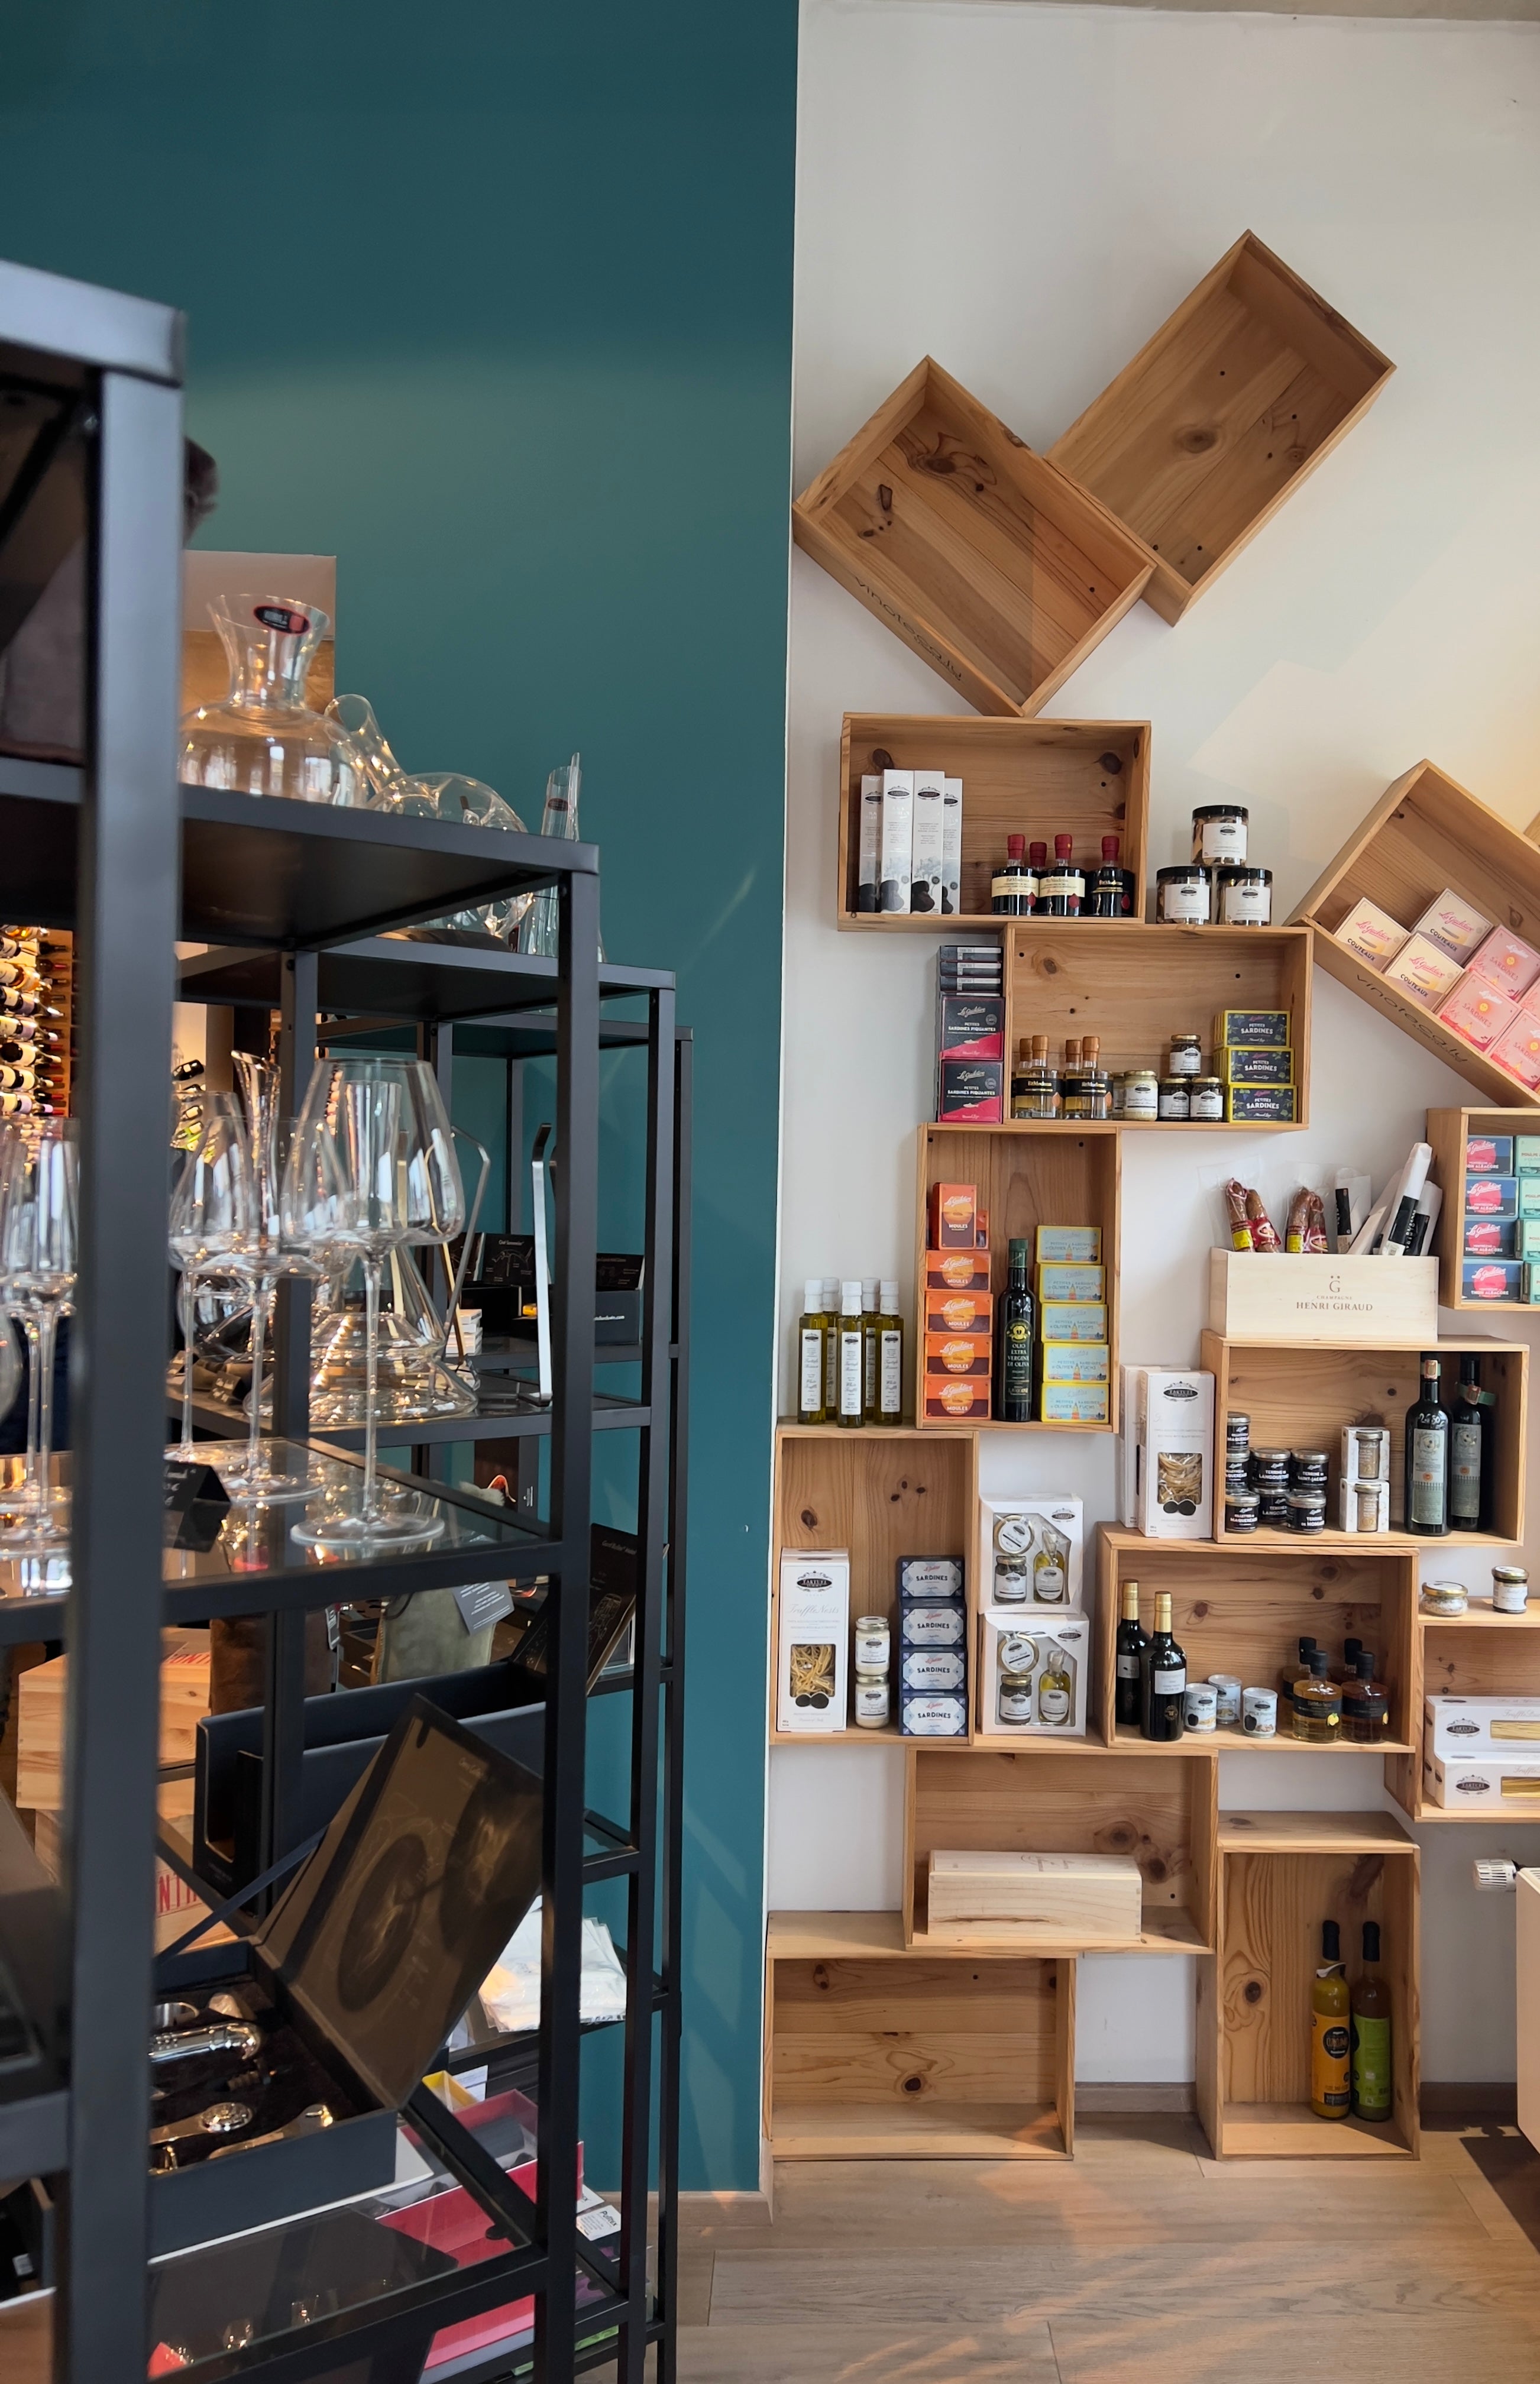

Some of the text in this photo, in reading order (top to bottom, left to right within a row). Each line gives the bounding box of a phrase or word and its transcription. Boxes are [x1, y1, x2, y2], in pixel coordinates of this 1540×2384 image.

[1347, 938, 1376, 962] COUTEAUX
[1429, 928, 1458, 952] COUTEAUX
[1489, 956, 1519, 981] SARDINES
[1400, 973, 1428, 998] COUTEAUX
[1462, 1002, 1492, 1028] SARDINES
[1296, 1302, 1373, 1311] HENRI GIRAUD
[787, 1604, 839, 1616] Truffle Nests
